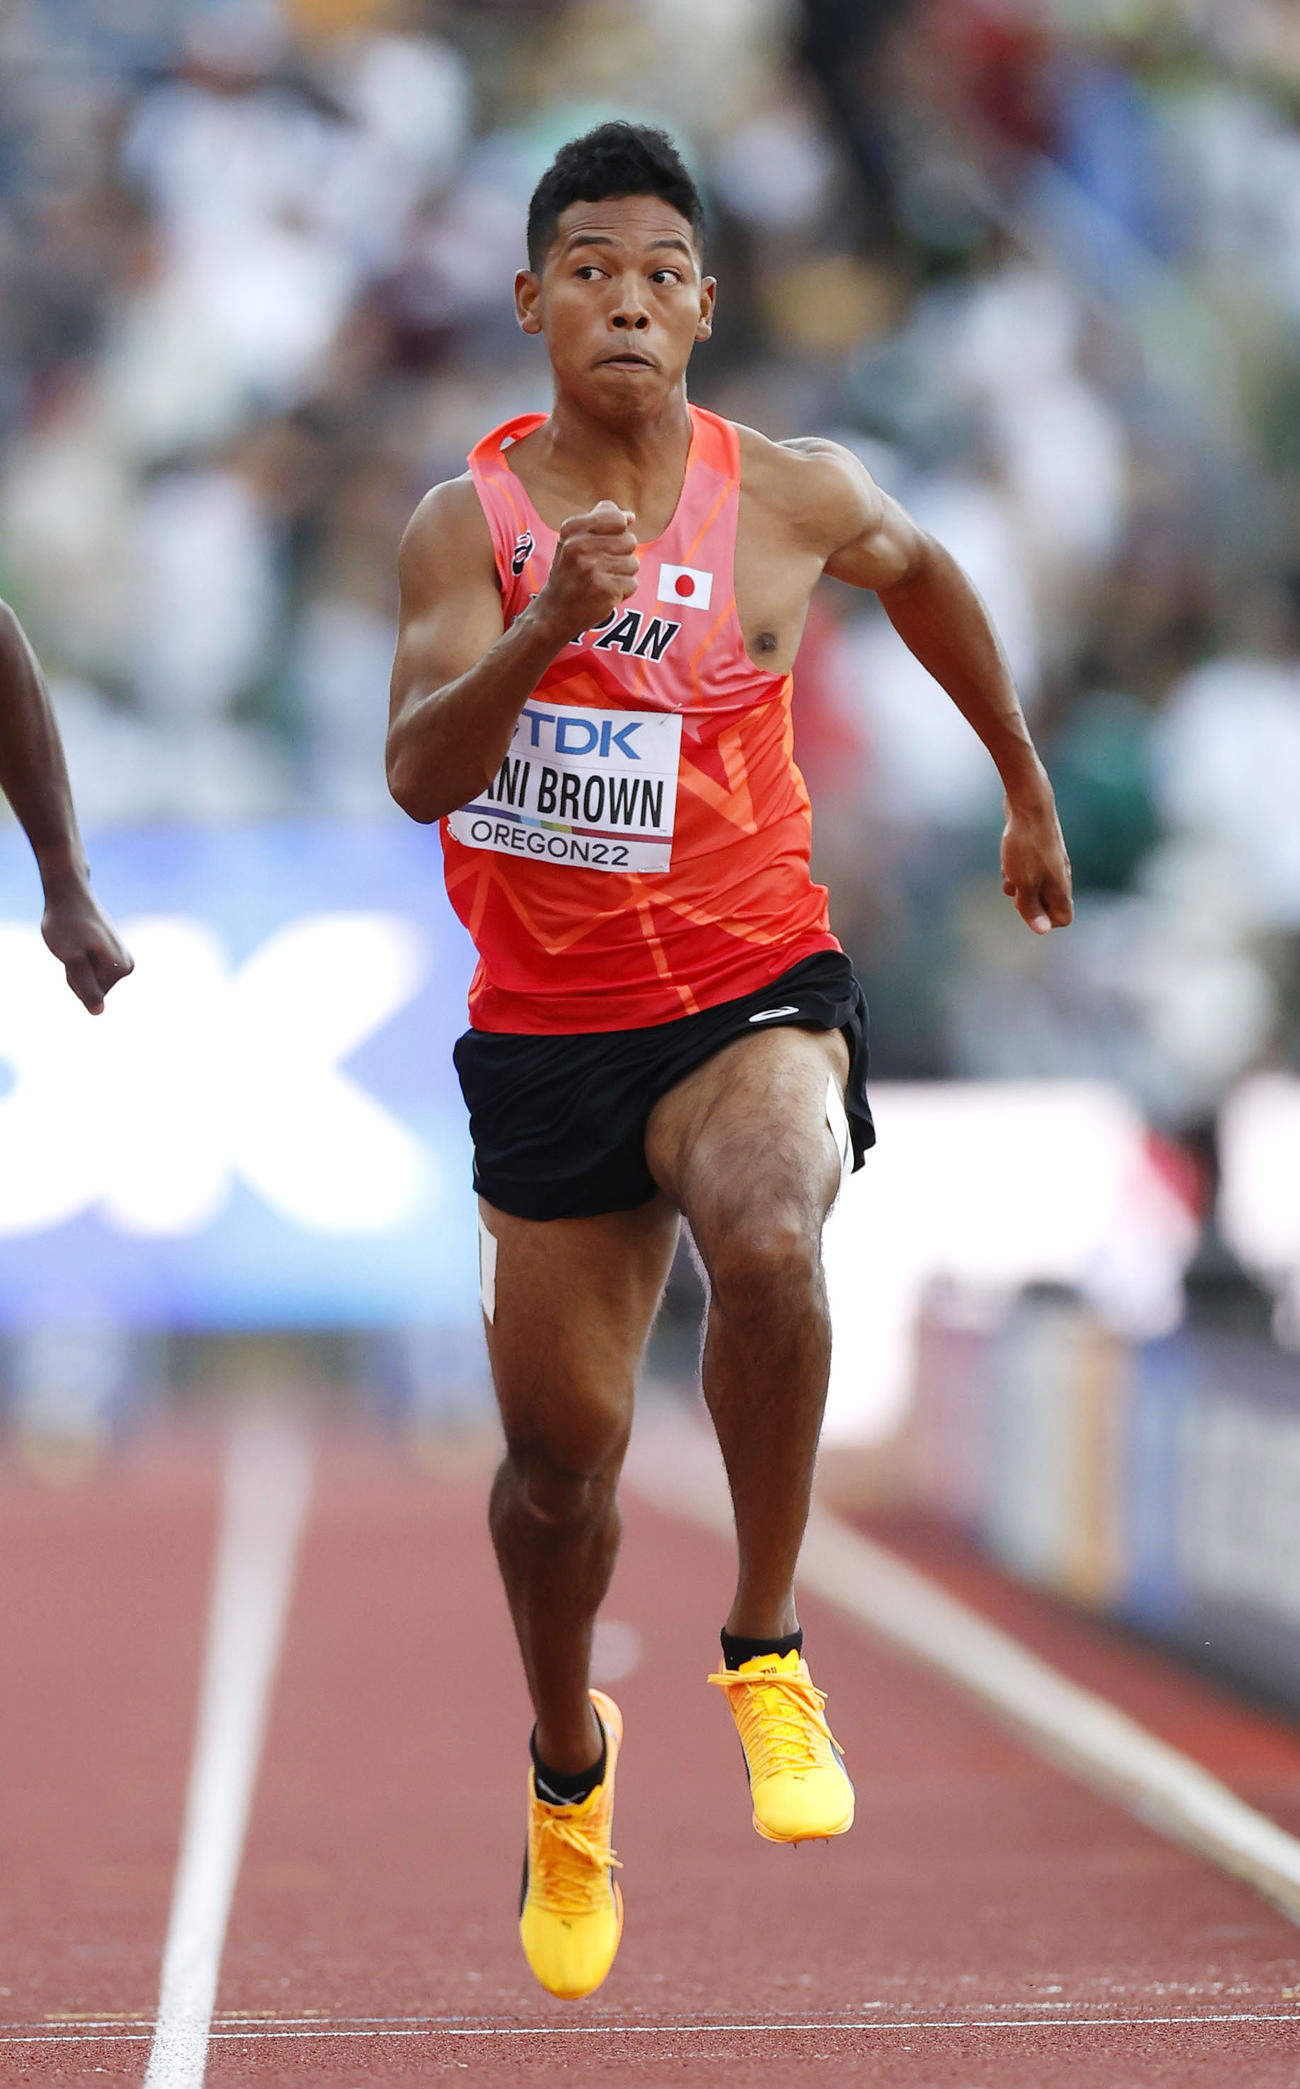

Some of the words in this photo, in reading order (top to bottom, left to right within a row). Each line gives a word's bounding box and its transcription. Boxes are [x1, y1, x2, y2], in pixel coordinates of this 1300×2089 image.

[521, 708, 644, 760] TDK
[537, 766, 664, 828] BROWN
[471, 820, 629, 866] OREGON22
